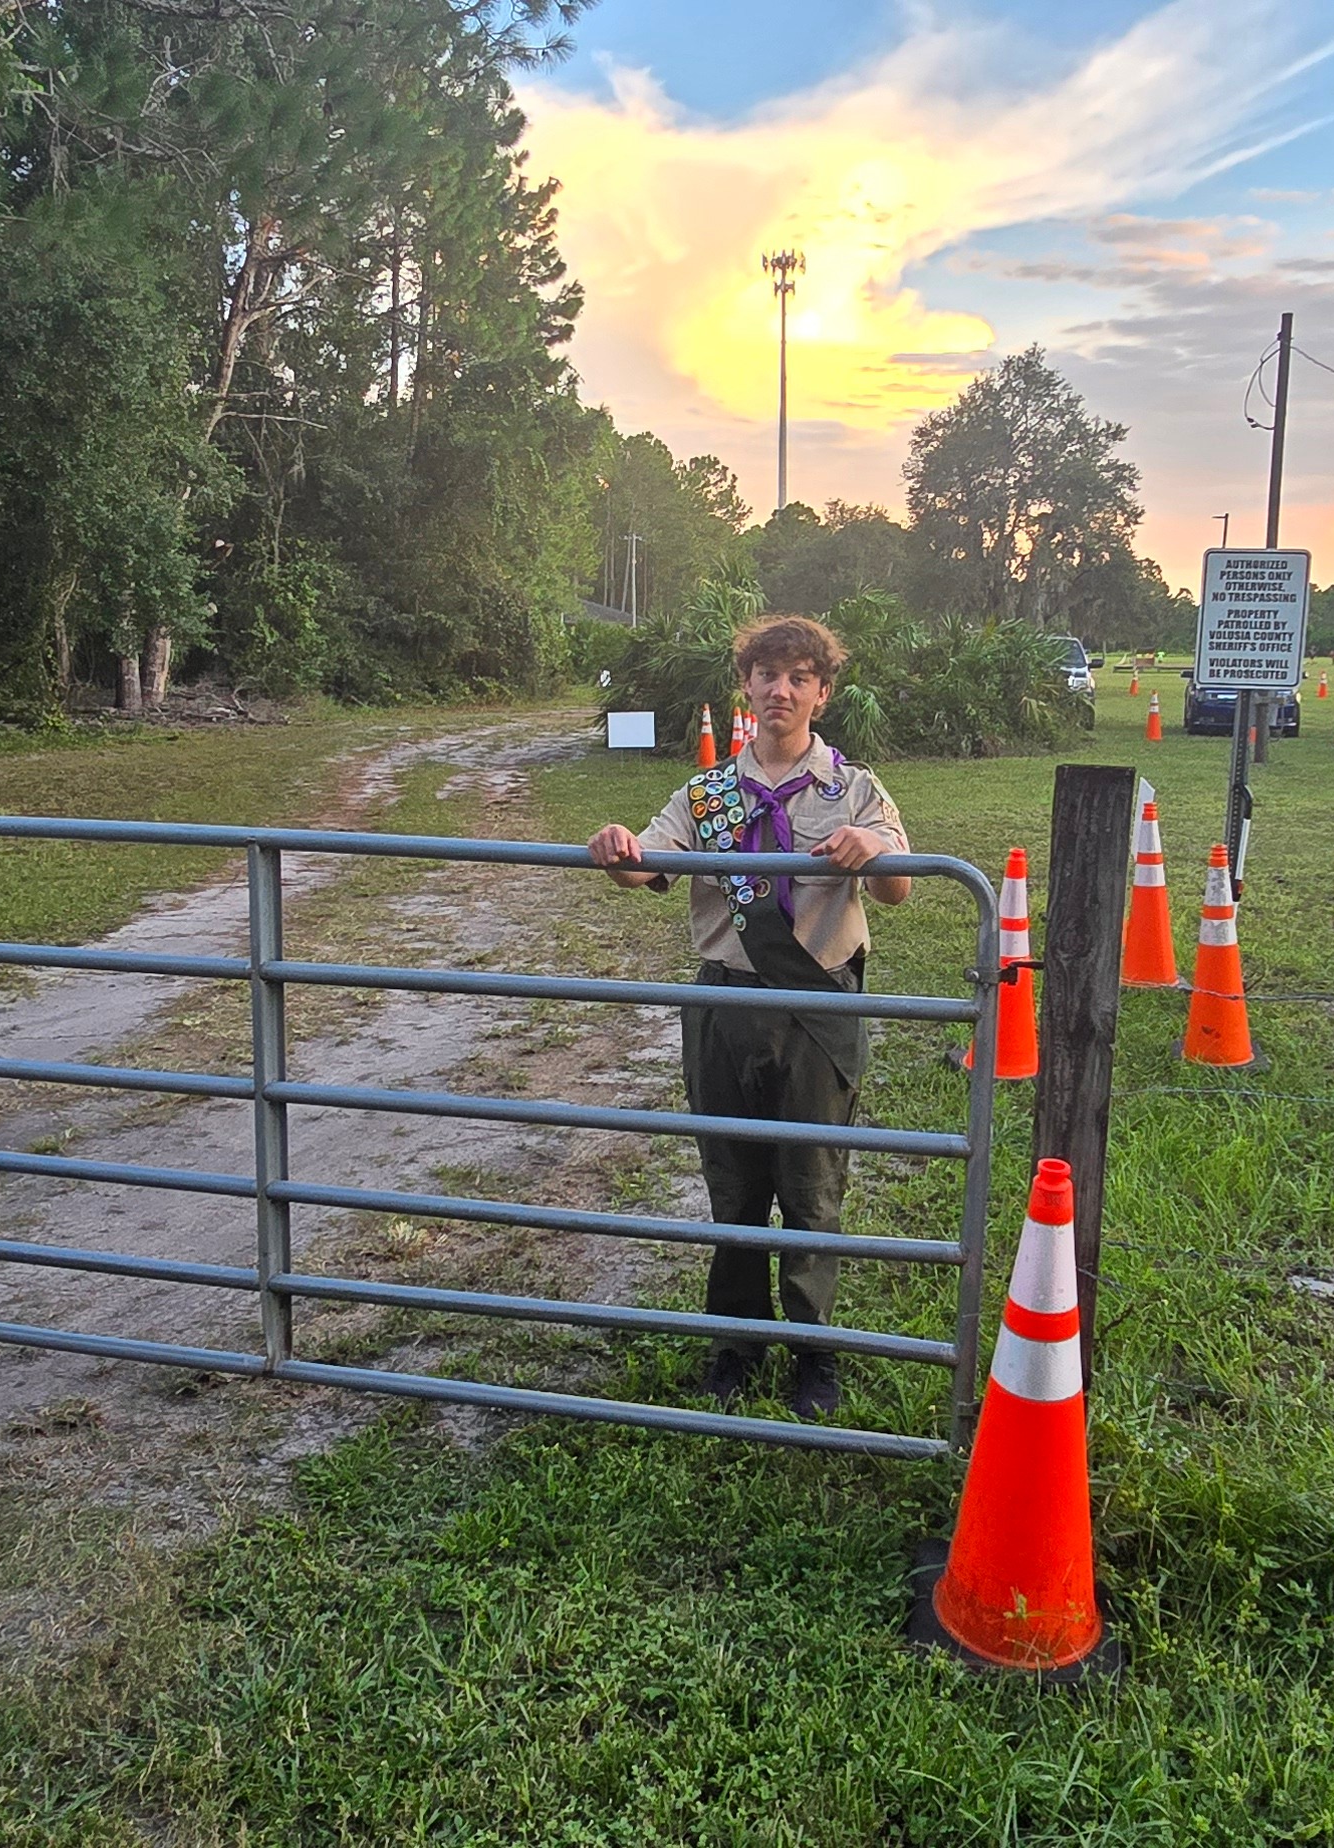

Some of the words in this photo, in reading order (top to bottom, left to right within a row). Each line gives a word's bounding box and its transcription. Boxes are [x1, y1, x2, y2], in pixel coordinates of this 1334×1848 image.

[1226, 560, 1287, 569] AUTHORIZED
[1219, 571, 1266, 580] PERSONS
[1268, 571, 1293, 580] ONLY
[1212, 592, 1226, 601] NO
[1228, 592, 1296, 602] TRESPASSING
[1227, 609, 1279, 619] PROPERTY
[1218, 620, 1271, 629] PATROLLED
[1274, 621, 1287, 630] BY
[1209, 631, 1251, 640] VOLUSIA
[1253, 632, 1294, 641] COUNTY
[1259, 643, 1293, 652] OFFICE
[1209, 658, 1263, 668] VIOLATORS
[1265, 660, 1289, 668] WILL
[1209, 669, 1221, 678] BE
[1224, 670, 1287, 679] PROSECUTED
